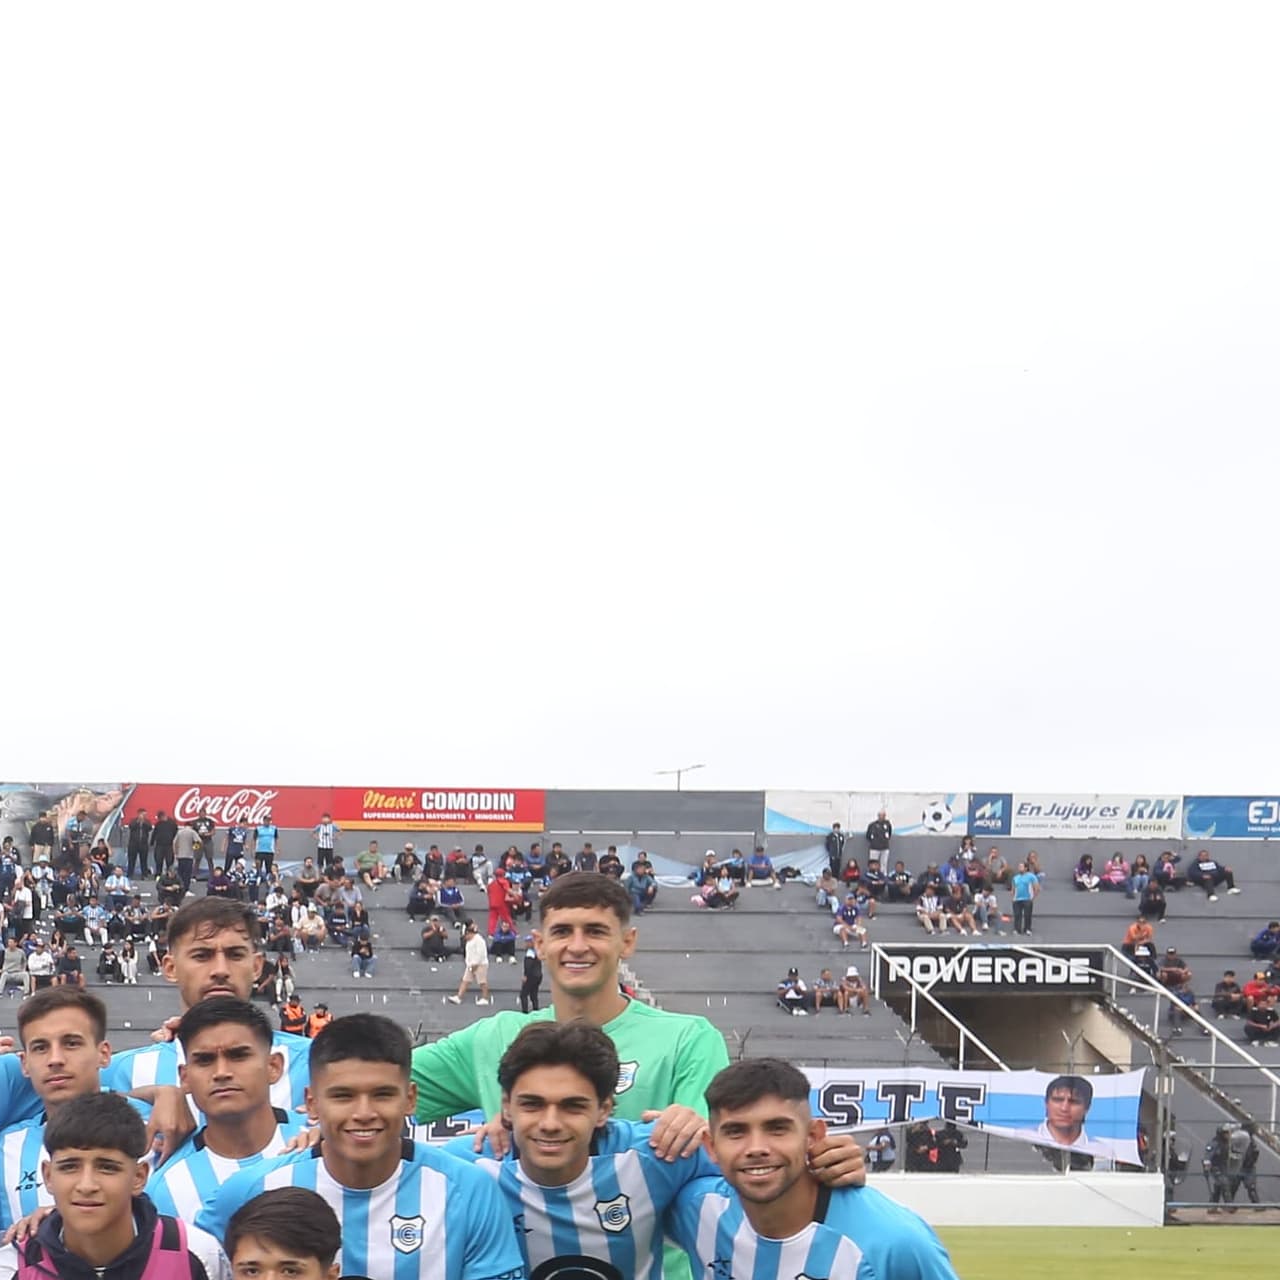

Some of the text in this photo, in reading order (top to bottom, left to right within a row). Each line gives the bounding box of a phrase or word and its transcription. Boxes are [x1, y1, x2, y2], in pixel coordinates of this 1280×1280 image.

[362, 790, 515, 811] Maxi COMODIN
[1017, 802, 1120, 820] En Jujuy es
[1126, 799, 1178, 820] RM
[890, 956, 1091, 984] POWERADE
